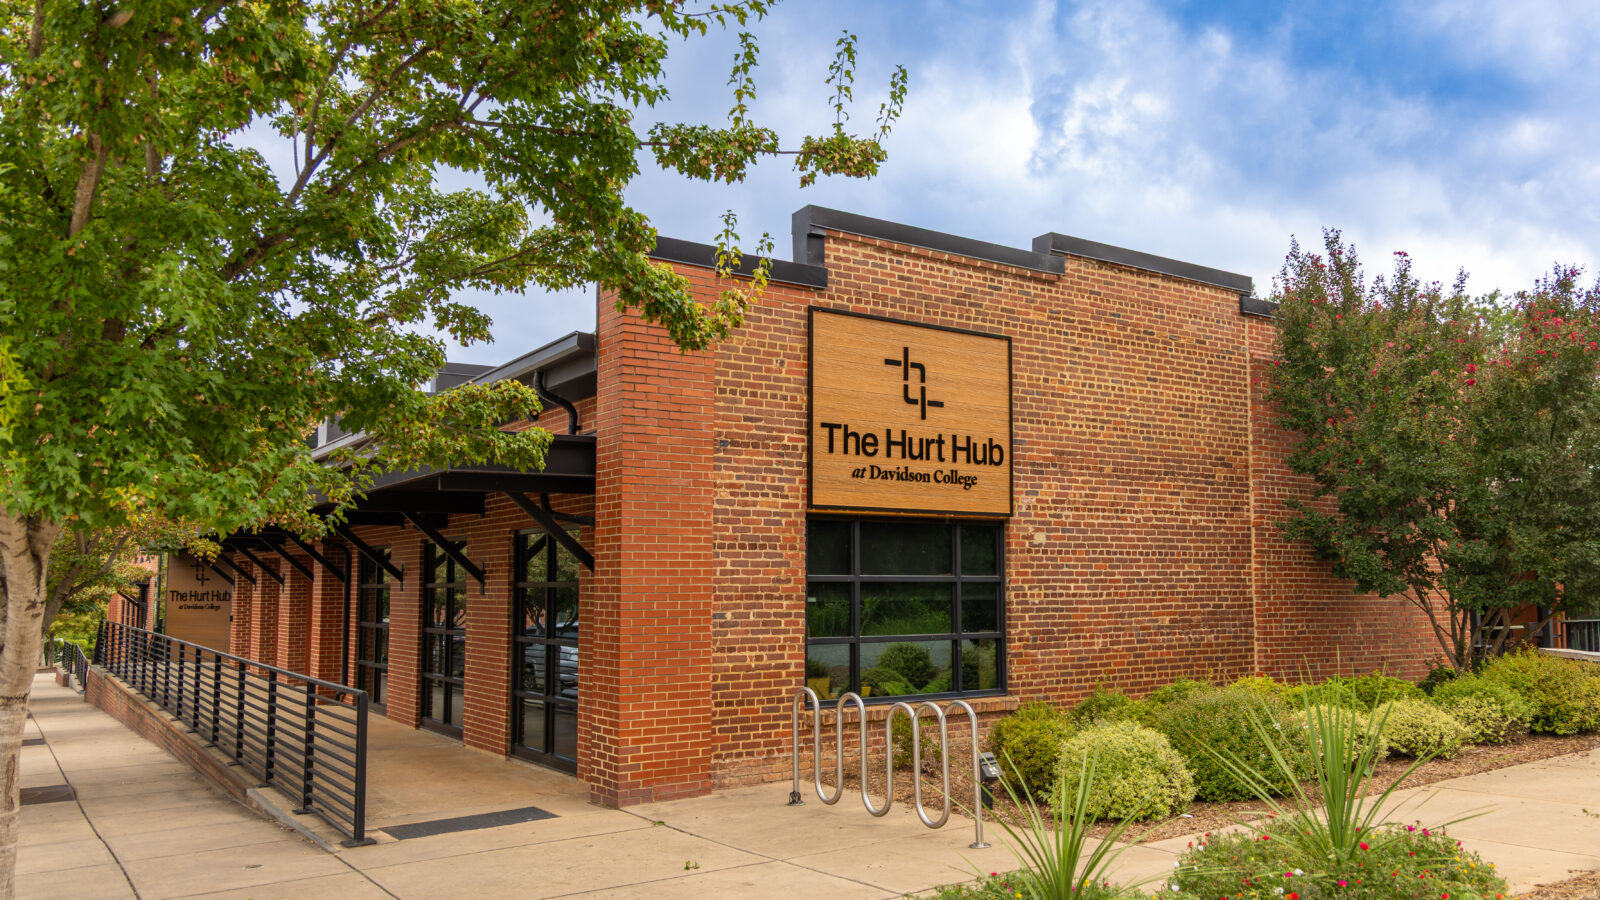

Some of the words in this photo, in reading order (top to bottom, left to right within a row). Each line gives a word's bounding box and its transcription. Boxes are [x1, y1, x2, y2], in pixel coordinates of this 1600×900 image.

[821, 422, 878, 457] The
[886, 428, 945, 462] Hurt
[952, 434, 1004, 467] Hub
[852, 466, 867, 479] at
[869, 465, 930, 482] Davidson
[934, 470, 978, 490] College
[170, 590, 187, 602] The
[190, 590, 210, 602] Hurt
[212, 590, 231, 602] Hub
